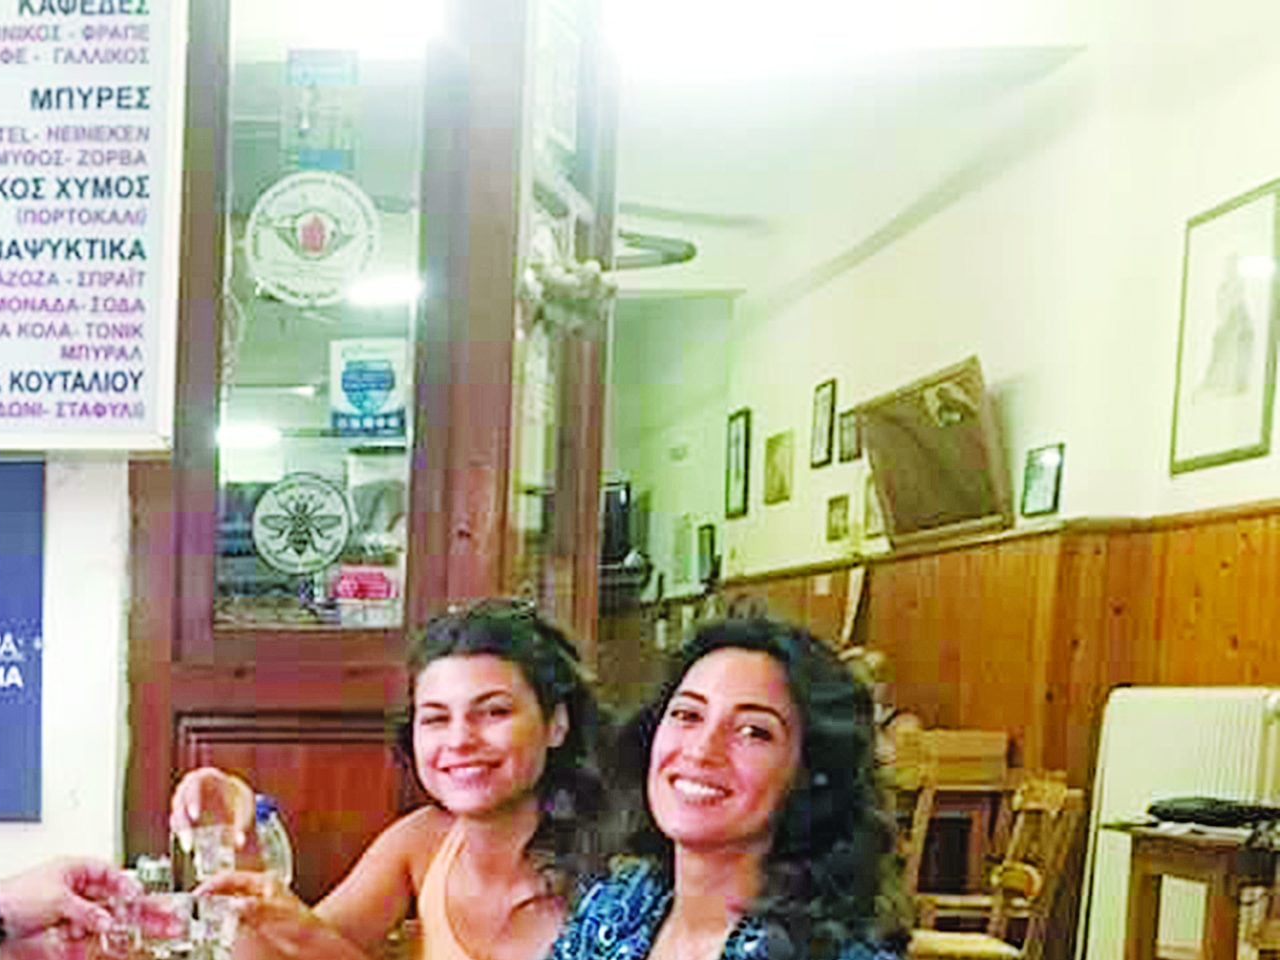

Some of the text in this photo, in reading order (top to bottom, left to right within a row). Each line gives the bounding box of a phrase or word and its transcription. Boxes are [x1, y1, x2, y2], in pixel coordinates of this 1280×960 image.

[18, 0, 150, 15] ΚΑΦΕΔΕΣ
[53, 48, 149, 64] ΓΑΛΛΙΚΟΣ
[29, 86, 151, 110] ΜΠΥΡΕΣ
[47, 126, 150, 143] HEINEKEN
[77, 149, 147, 166] ΖΟΡΒΑ
[55, 175, 150, 199] ΧΥΜΟΣ
[85, 322, 144, 339] ΤΟΝΙΚ
[8, 370, 144, 393] ΚΟΥΤΑΛΙΟΥ
